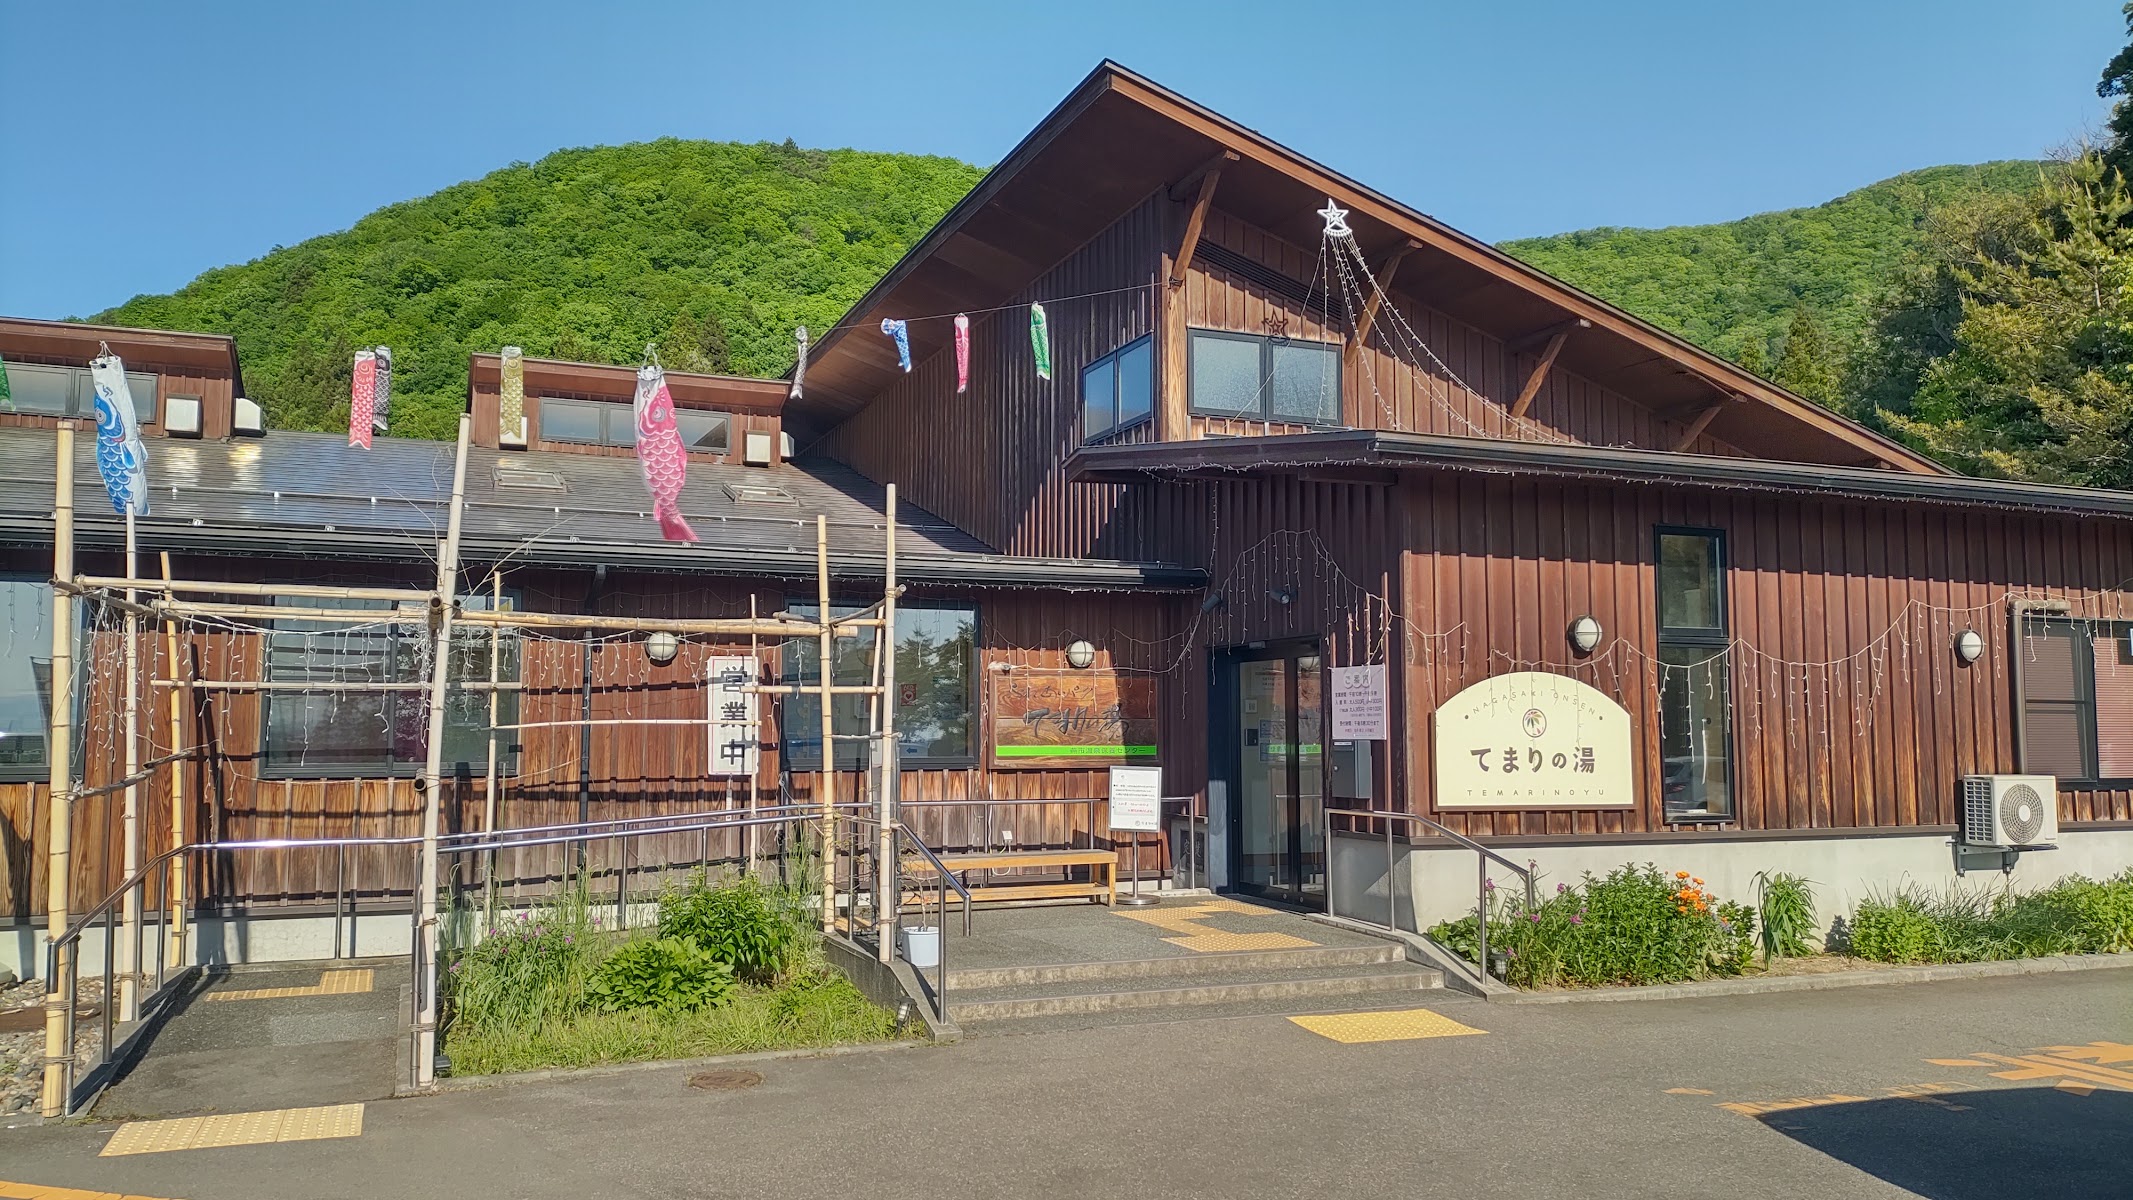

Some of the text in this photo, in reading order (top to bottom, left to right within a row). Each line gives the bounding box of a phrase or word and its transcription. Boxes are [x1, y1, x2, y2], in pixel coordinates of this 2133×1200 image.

[720, 666, 748, 765] 営業中
[1473, 691, 1595, 715] NAGASAKI ONSEN
[1470, 746, 1596, 774] てまりの湯
[1467, 789, 1604, 797] TEMARINOYU
